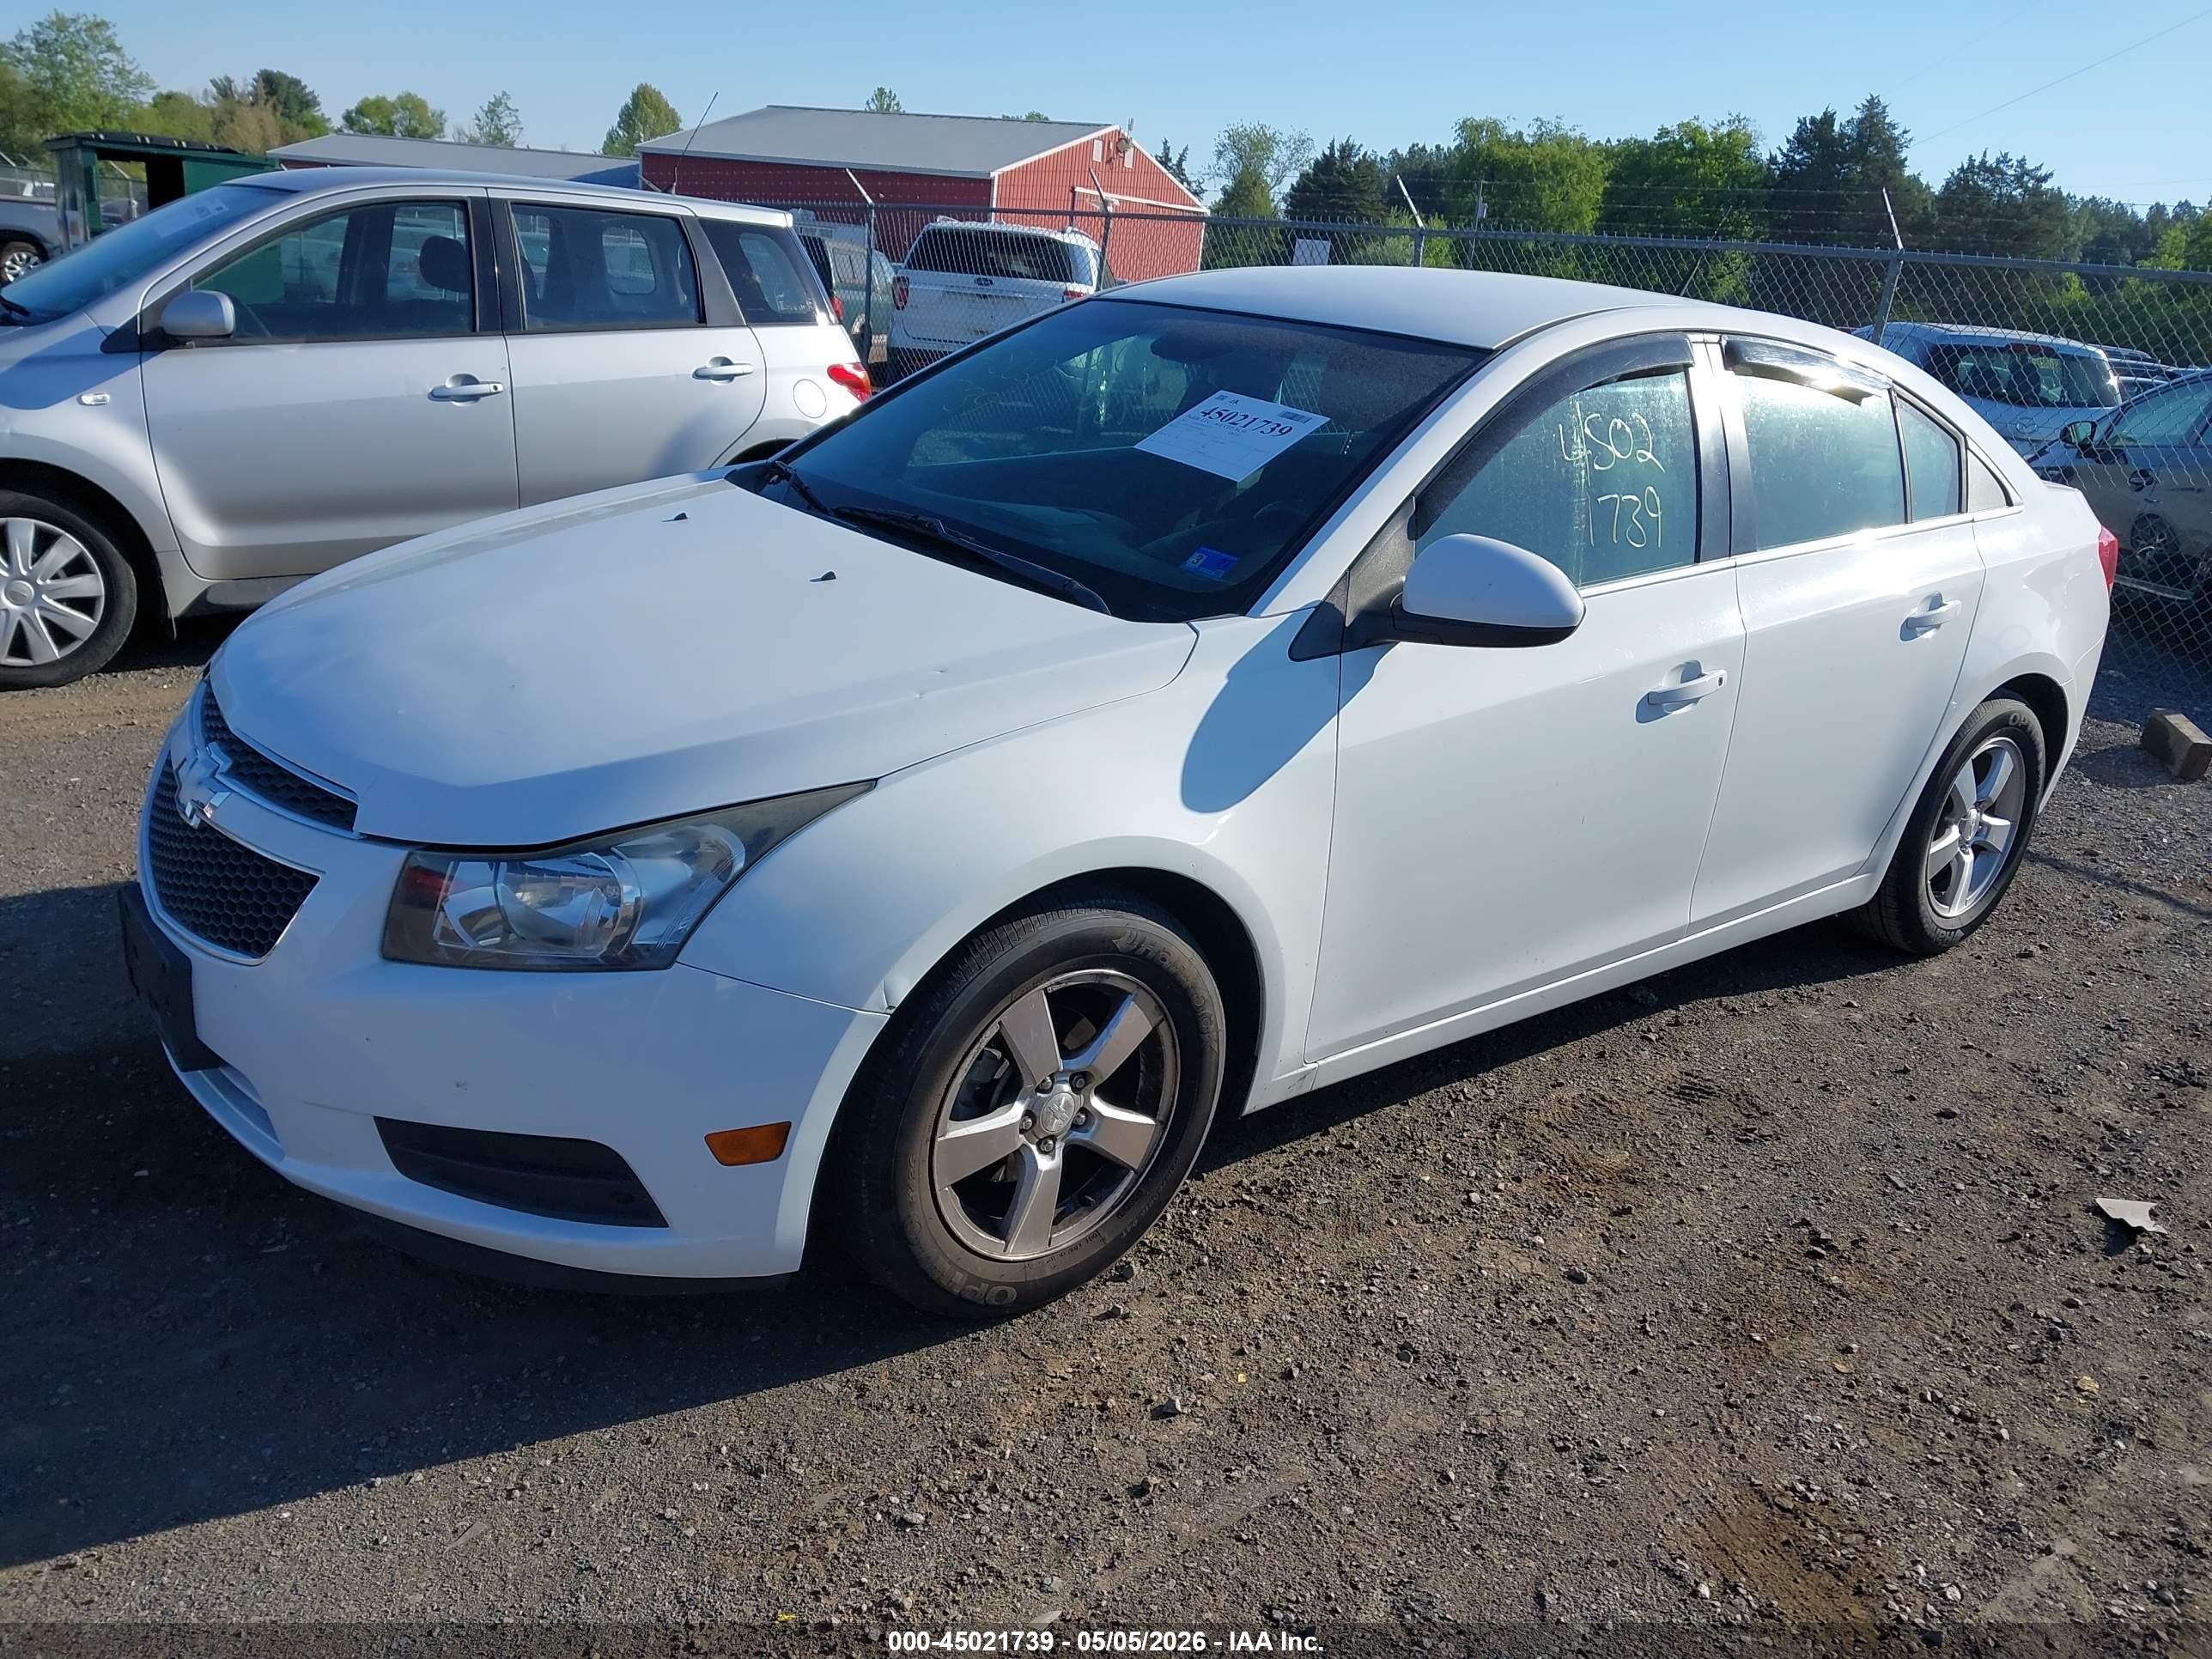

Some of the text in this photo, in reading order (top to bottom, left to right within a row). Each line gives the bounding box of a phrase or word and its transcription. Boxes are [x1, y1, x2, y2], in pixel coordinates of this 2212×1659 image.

[1200, 406, 1293, 437] 45021739
[1559, 401, 1666, 488] 4502
[1588, 485, 1662, 549] 1739
